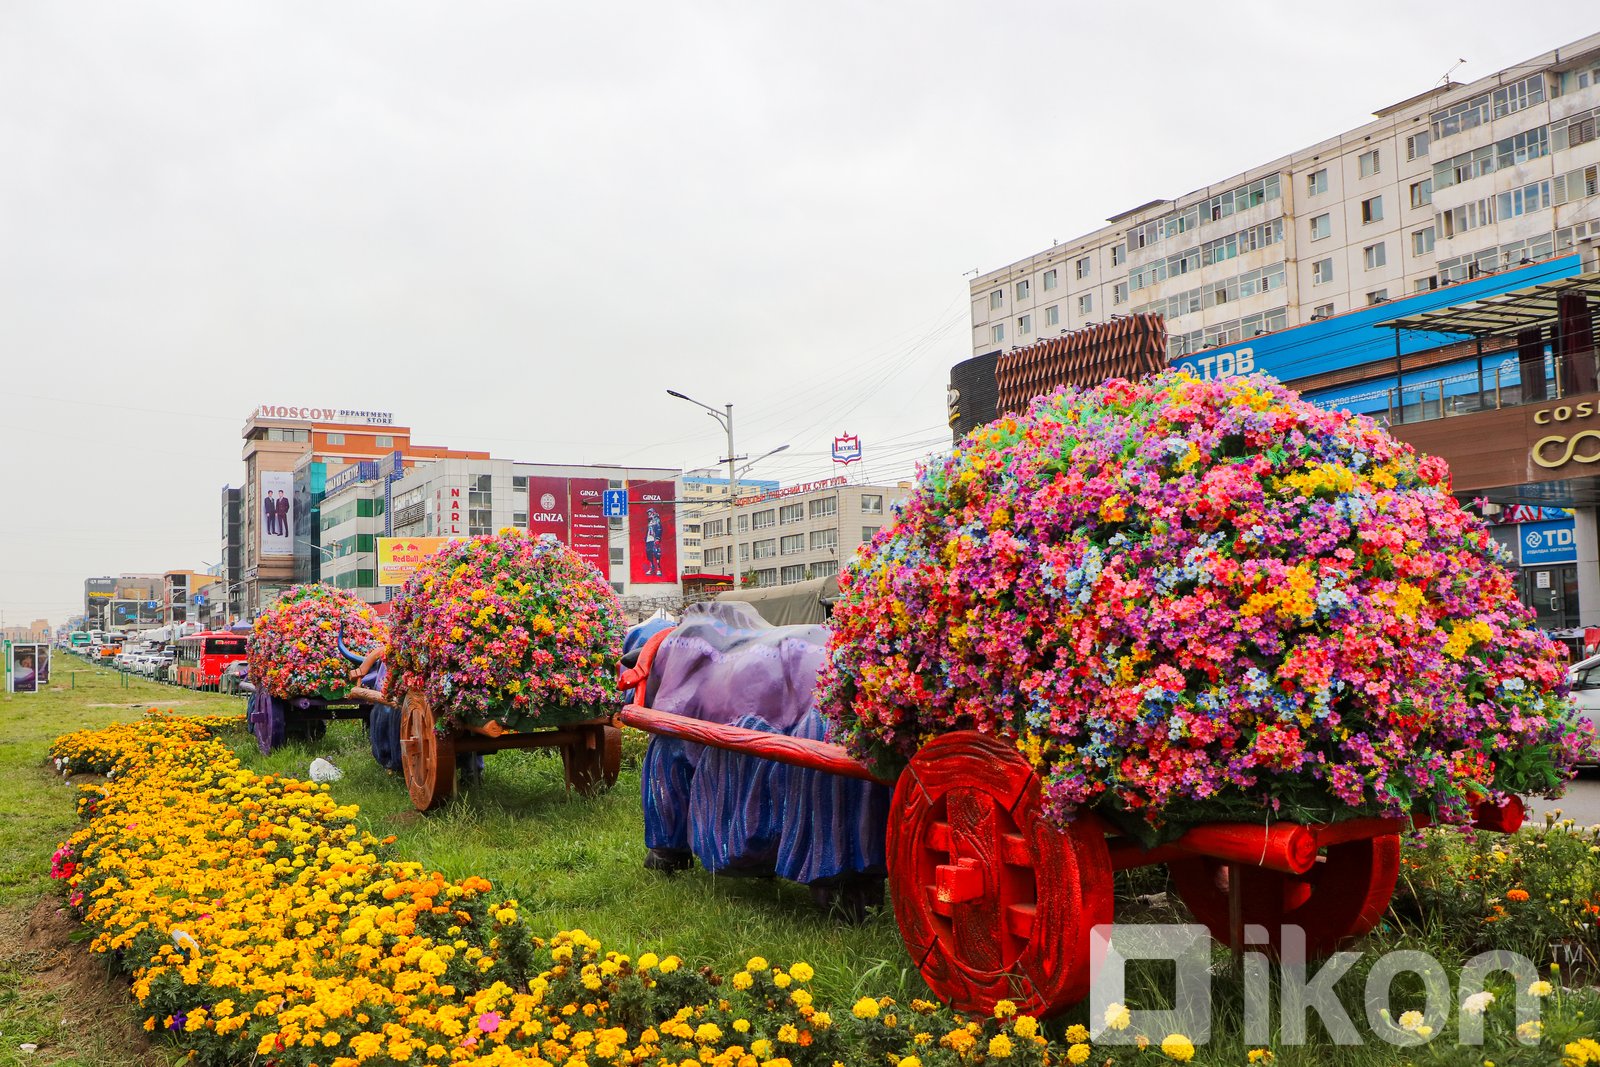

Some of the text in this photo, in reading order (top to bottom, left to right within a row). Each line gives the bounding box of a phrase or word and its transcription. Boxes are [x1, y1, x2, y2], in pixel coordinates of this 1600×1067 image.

[1198, 347, 1254, 382] TDB
[262, 405, 393, 420] MOSCOW DEPARTMENT
[1534, 400, 1600, 425] COS
[533, 512, 563, 522] GINZA
